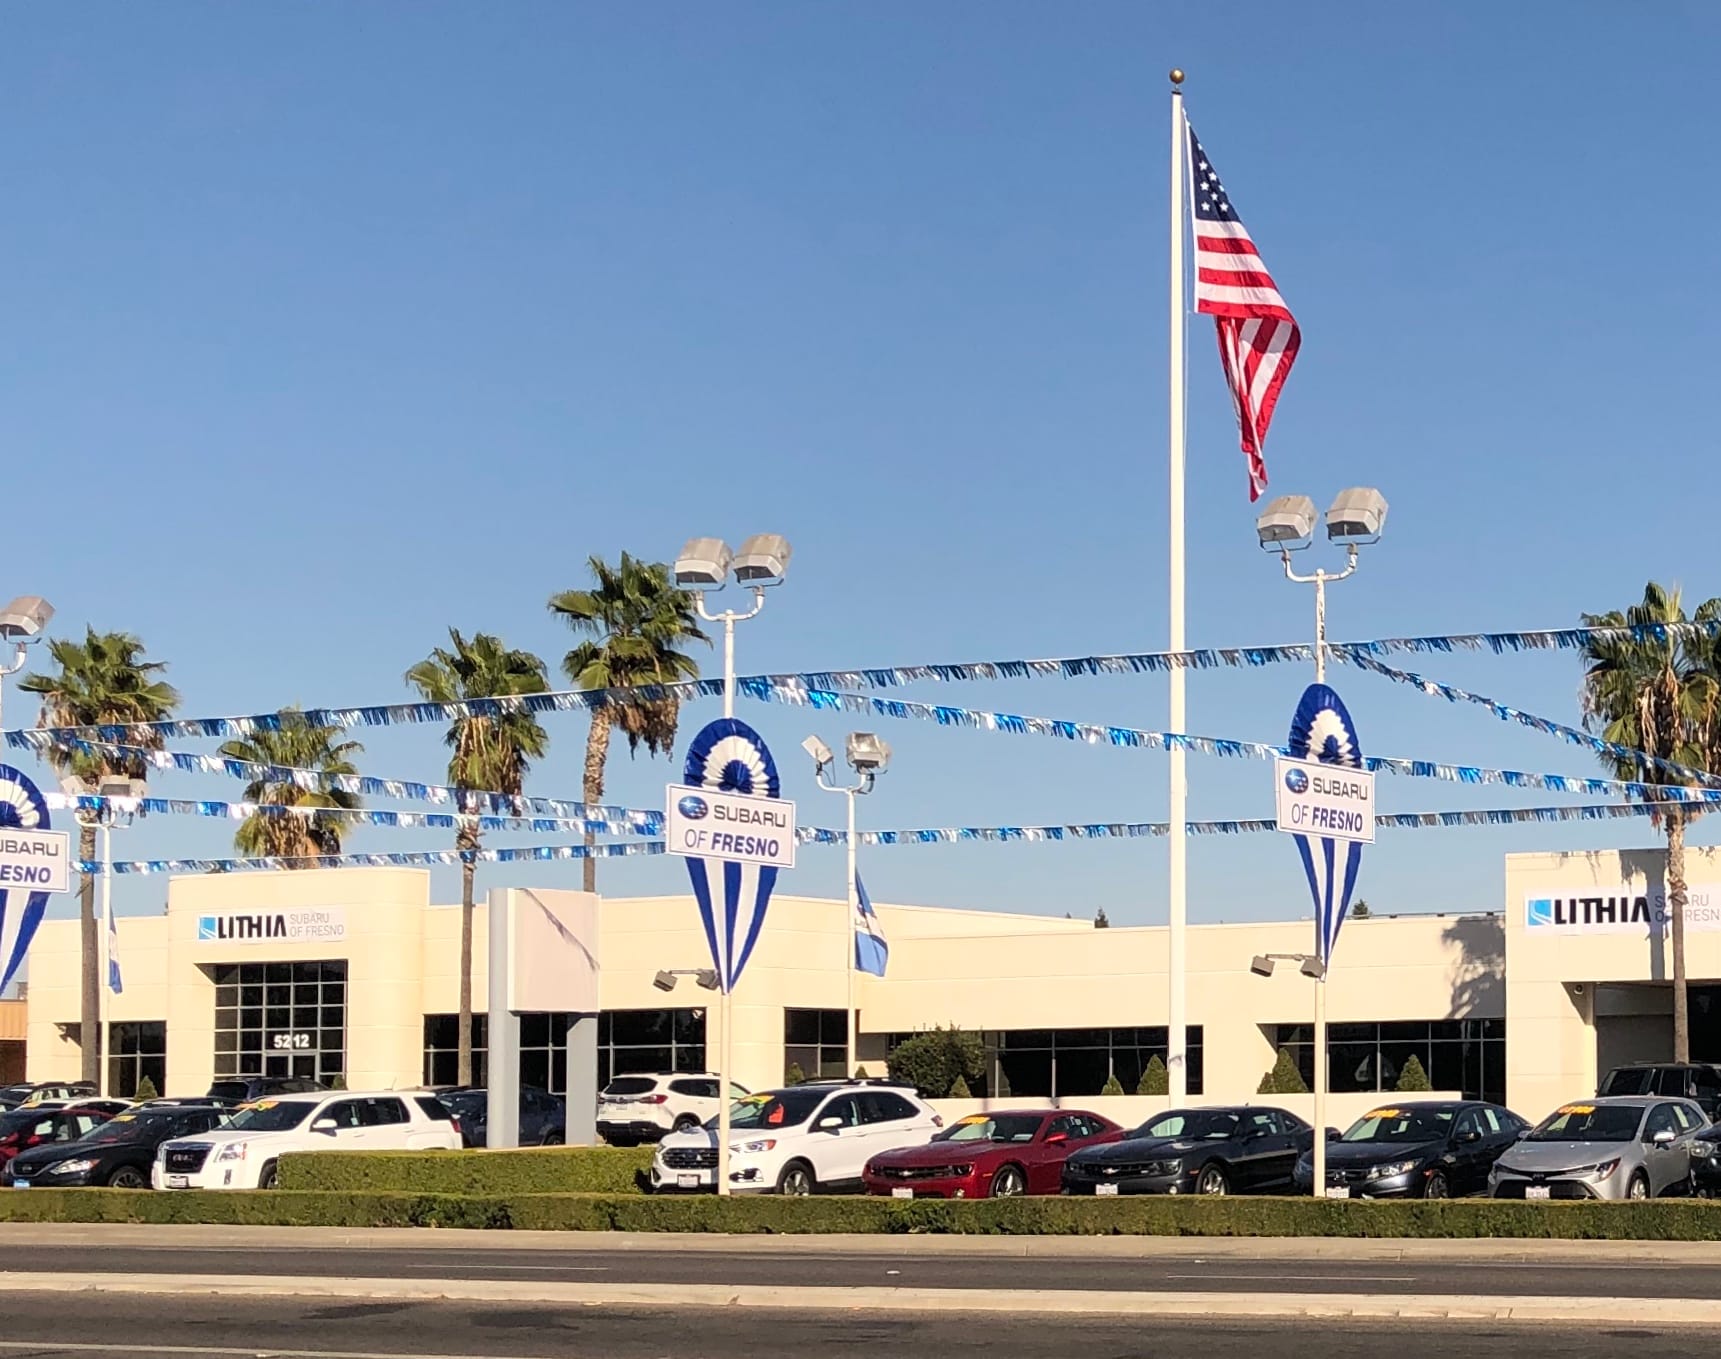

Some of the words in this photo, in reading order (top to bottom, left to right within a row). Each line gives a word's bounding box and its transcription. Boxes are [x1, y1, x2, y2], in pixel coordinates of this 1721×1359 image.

[1313, 777, 1368, 801] SUBARU
[713, 804, 786, 828] SUBARU
[1291, 803, 1310, 825] OF
[1312, 806, 1363, 833] FRESNO
[684, 828, 708, 849] OF
[711, 832, 779, 858] FRESNO
[289, 913, 330, 925] SUBARU
[1554, 896, 1652, 925] LITHIA
[218, 914, 287, 939] LITHIA
[289, 925, 304, 938] OF
[305, 924, 345, 937] FRESNO
[273, 1033, 310, 1049] 5212
